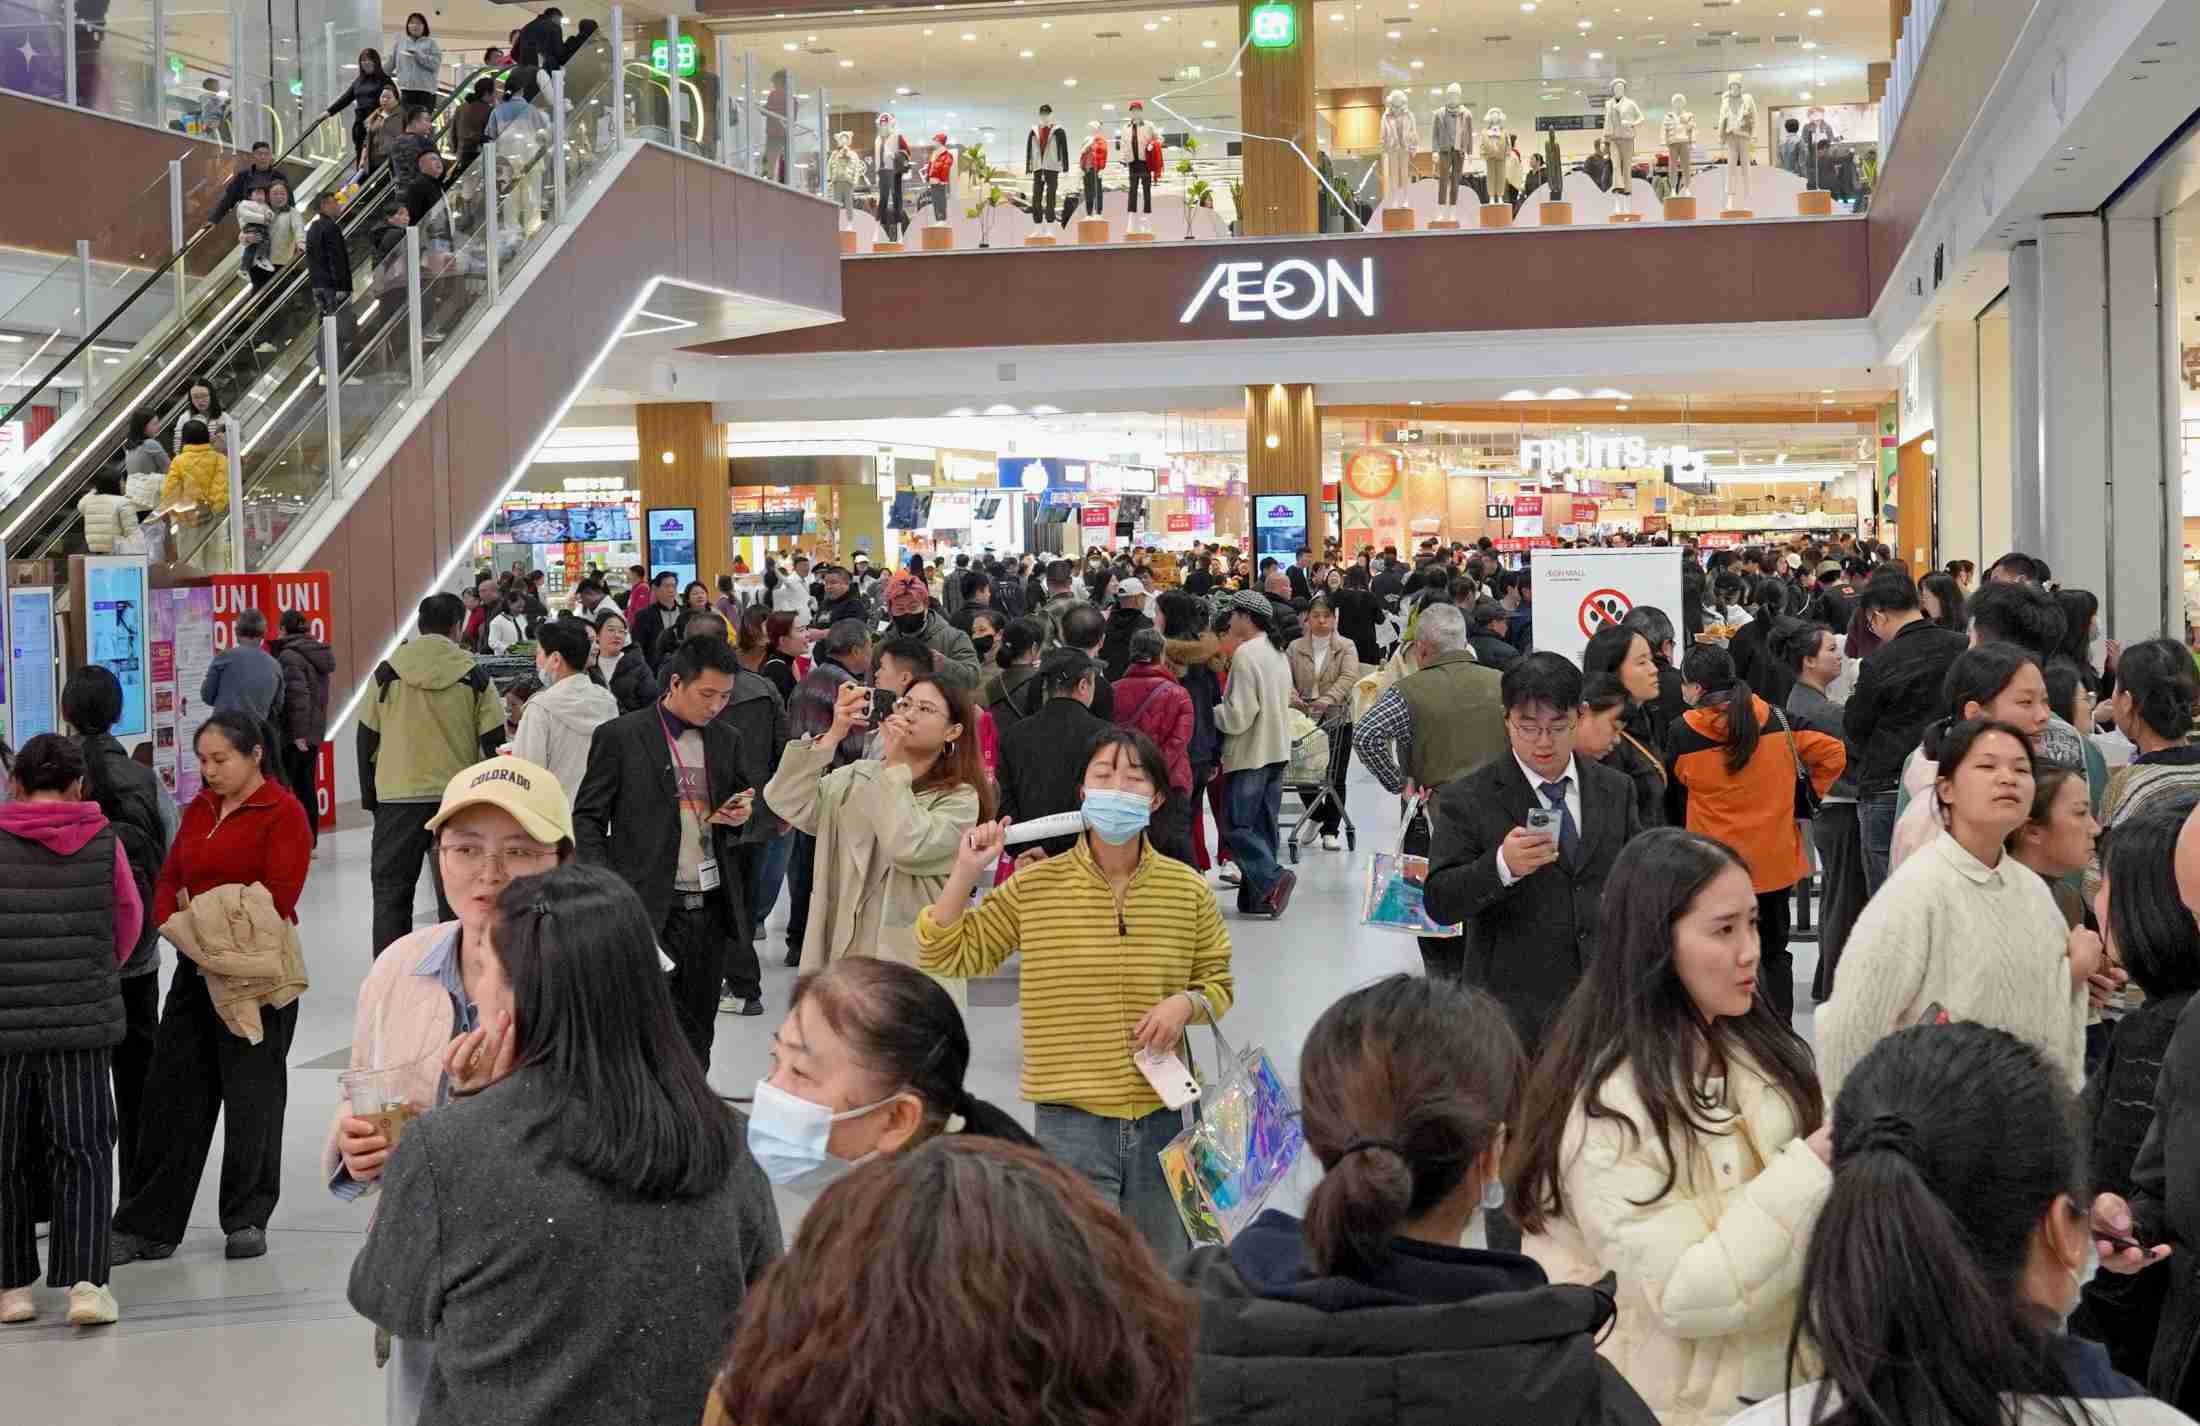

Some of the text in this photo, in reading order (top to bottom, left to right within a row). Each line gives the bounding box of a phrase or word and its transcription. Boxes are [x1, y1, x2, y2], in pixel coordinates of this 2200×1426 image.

[1519, 433, 1650, 471] FRUITS
[212, 584, 258, 613] UNI
[277, 582, 320, 612] UNI
[470, 769, 531, 790] COLORADO
